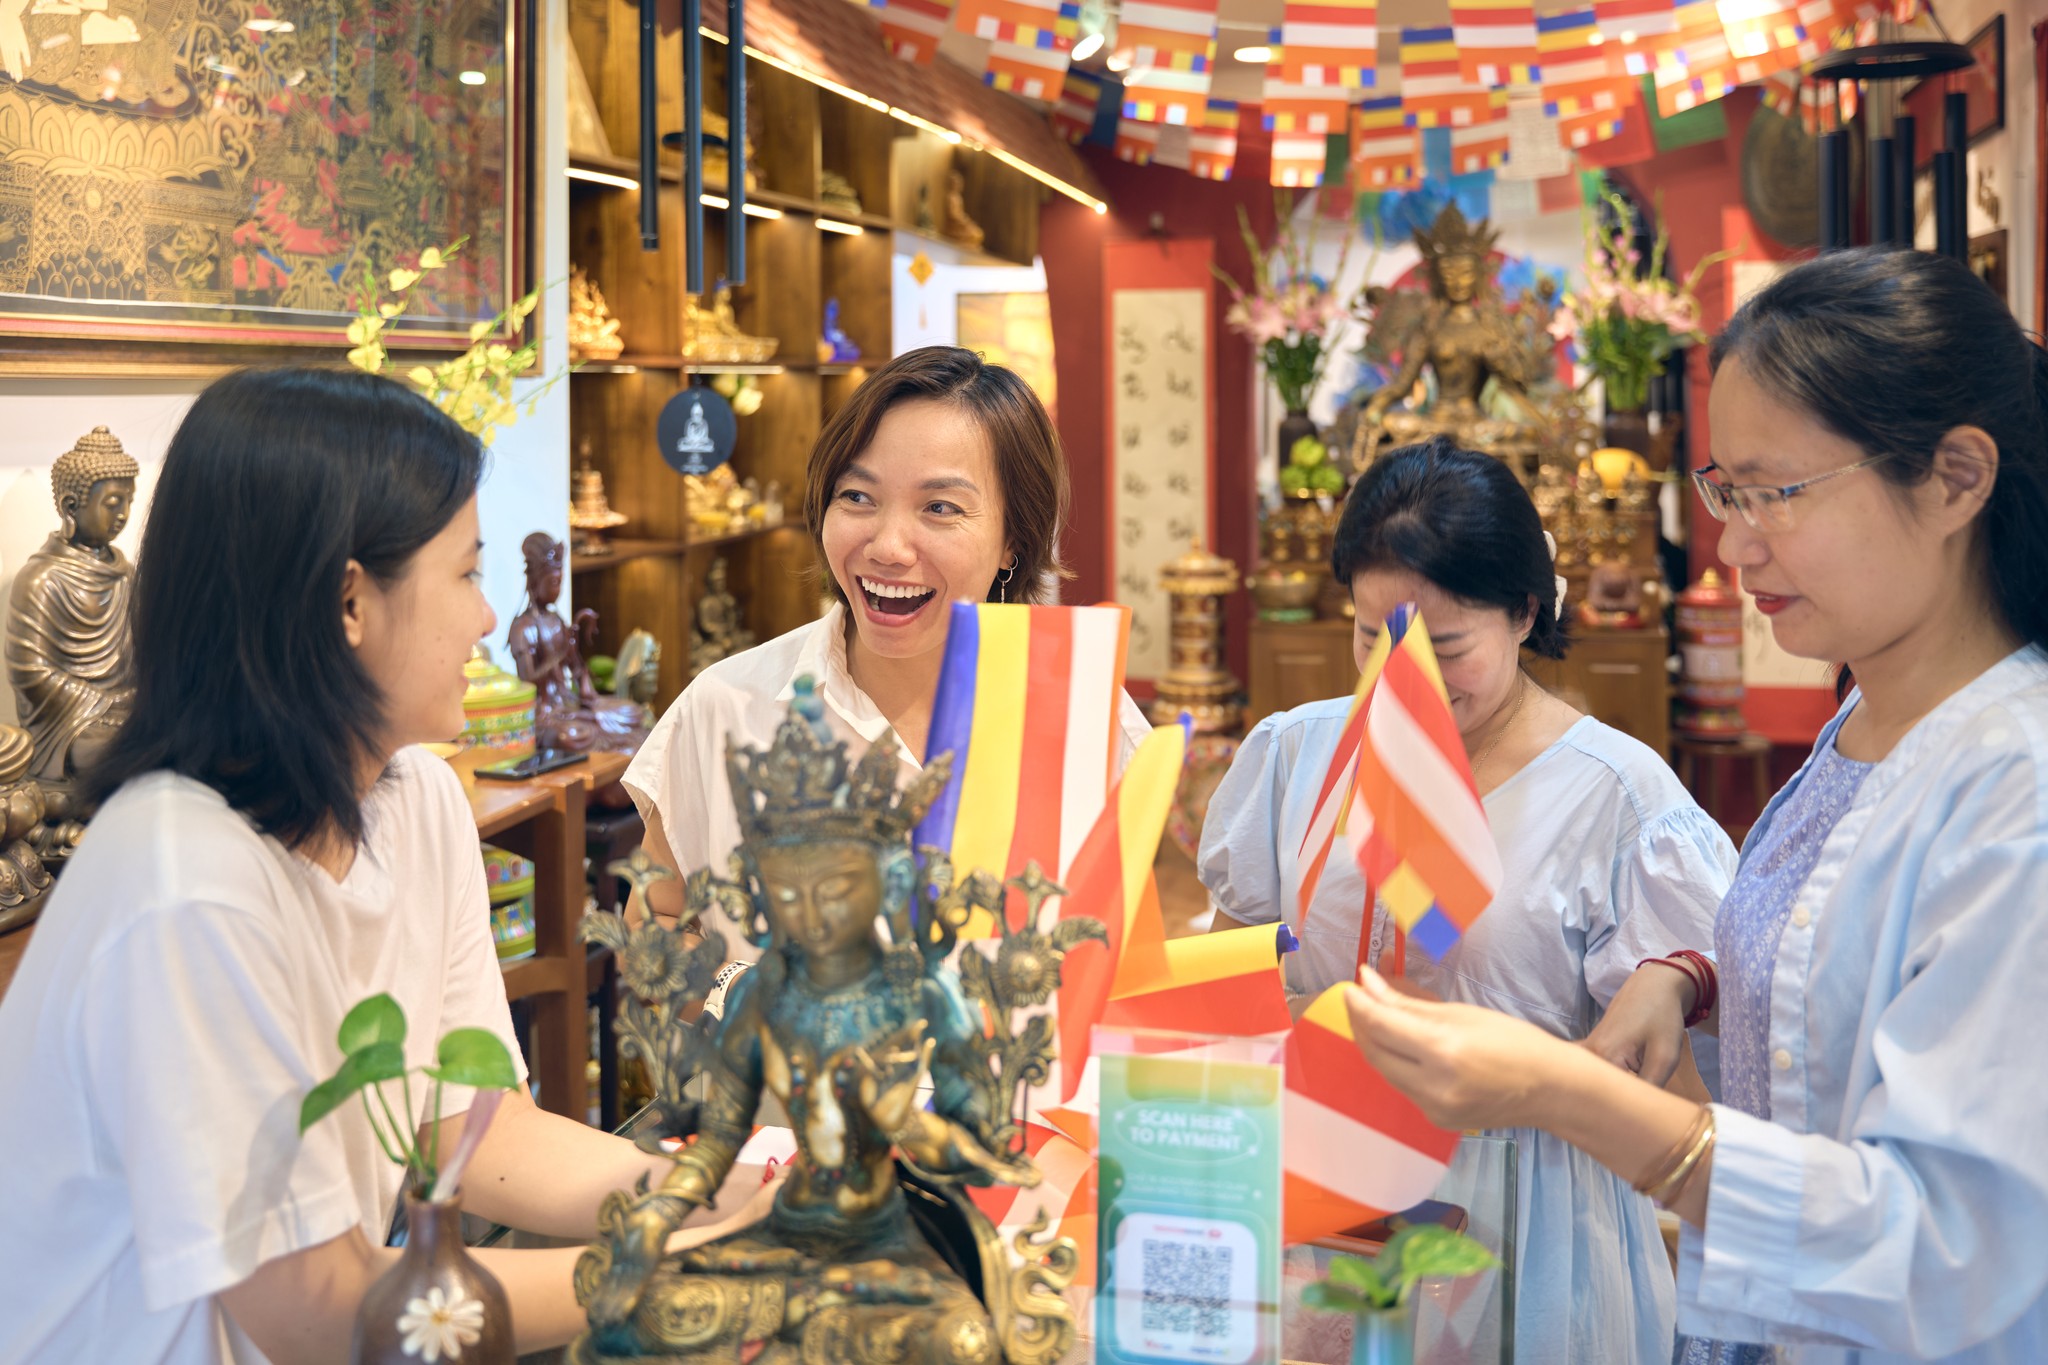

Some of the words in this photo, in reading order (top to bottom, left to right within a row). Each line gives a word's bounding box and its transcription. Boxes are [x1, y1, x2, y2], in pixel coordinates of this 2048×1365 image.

[1137, 1108, 1187, 1127] SCAN
[1190, 1113, 1234, 1132] HERE
[1130, 1126, 1155, 1144] TO
[1157, 1130, 1242, 1151] PAYMENT
